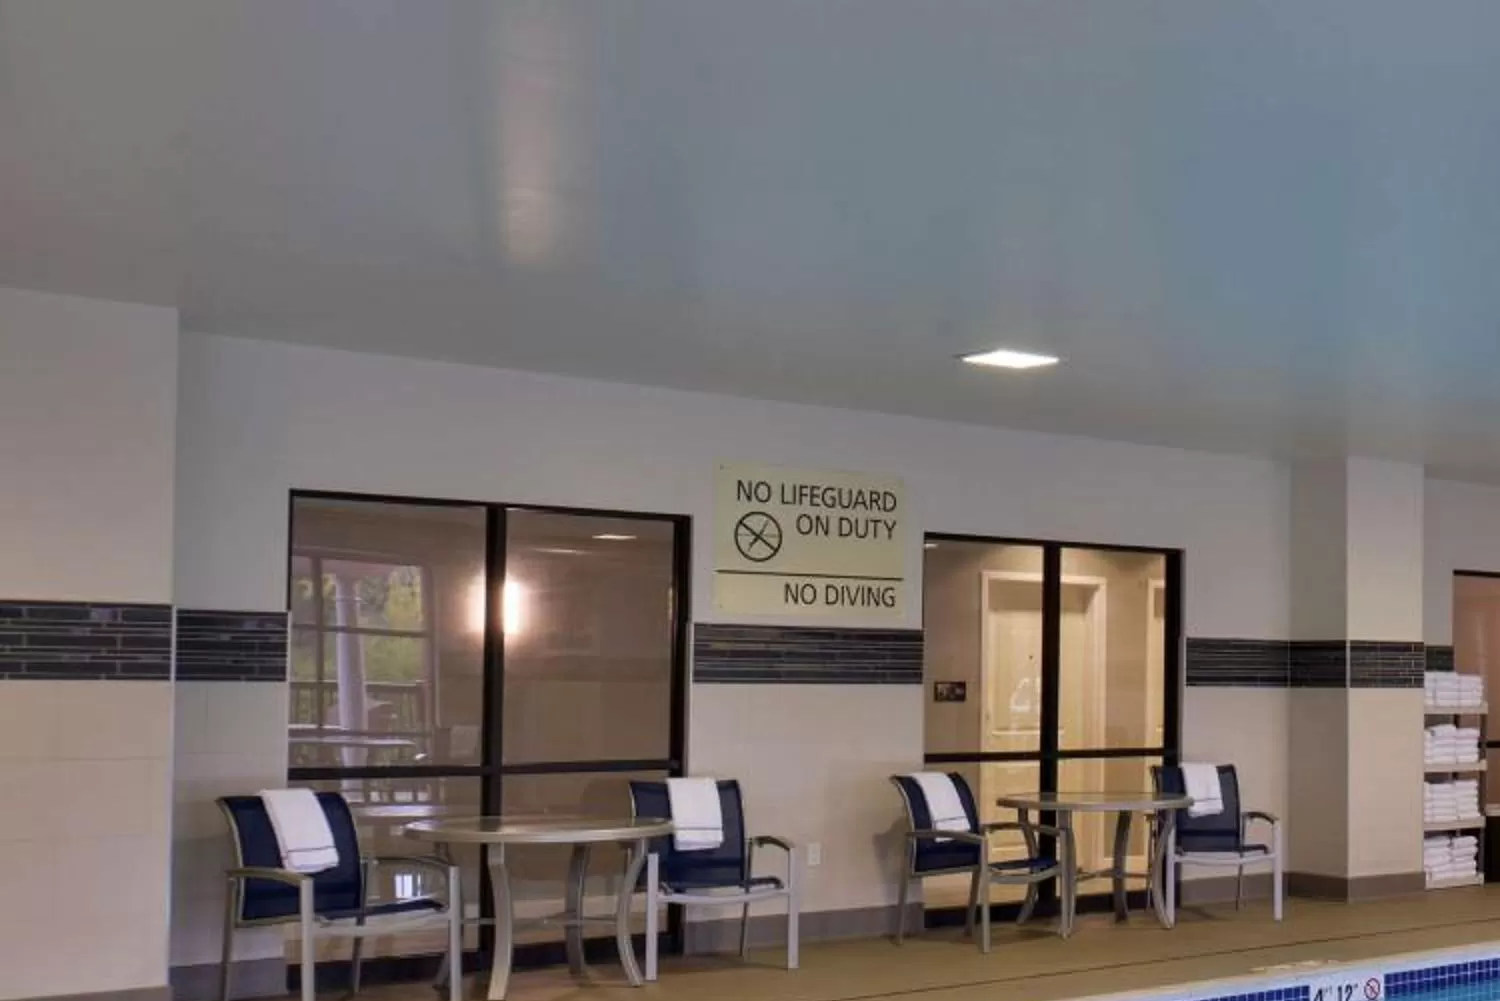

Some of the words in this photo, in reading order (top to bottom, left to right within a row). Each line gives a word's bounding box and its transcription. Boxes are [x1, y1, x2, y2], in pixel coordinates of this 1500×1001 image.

[737, 480, 772, 503] NO
[781, 483, 897, 512] LIFEGUARD
[796, 514, 829, 537] ON
[838, 517, 897, 540] DUTY
[784, 583, 817, 605] NO
[825, 584, 896, 608] DIVING
